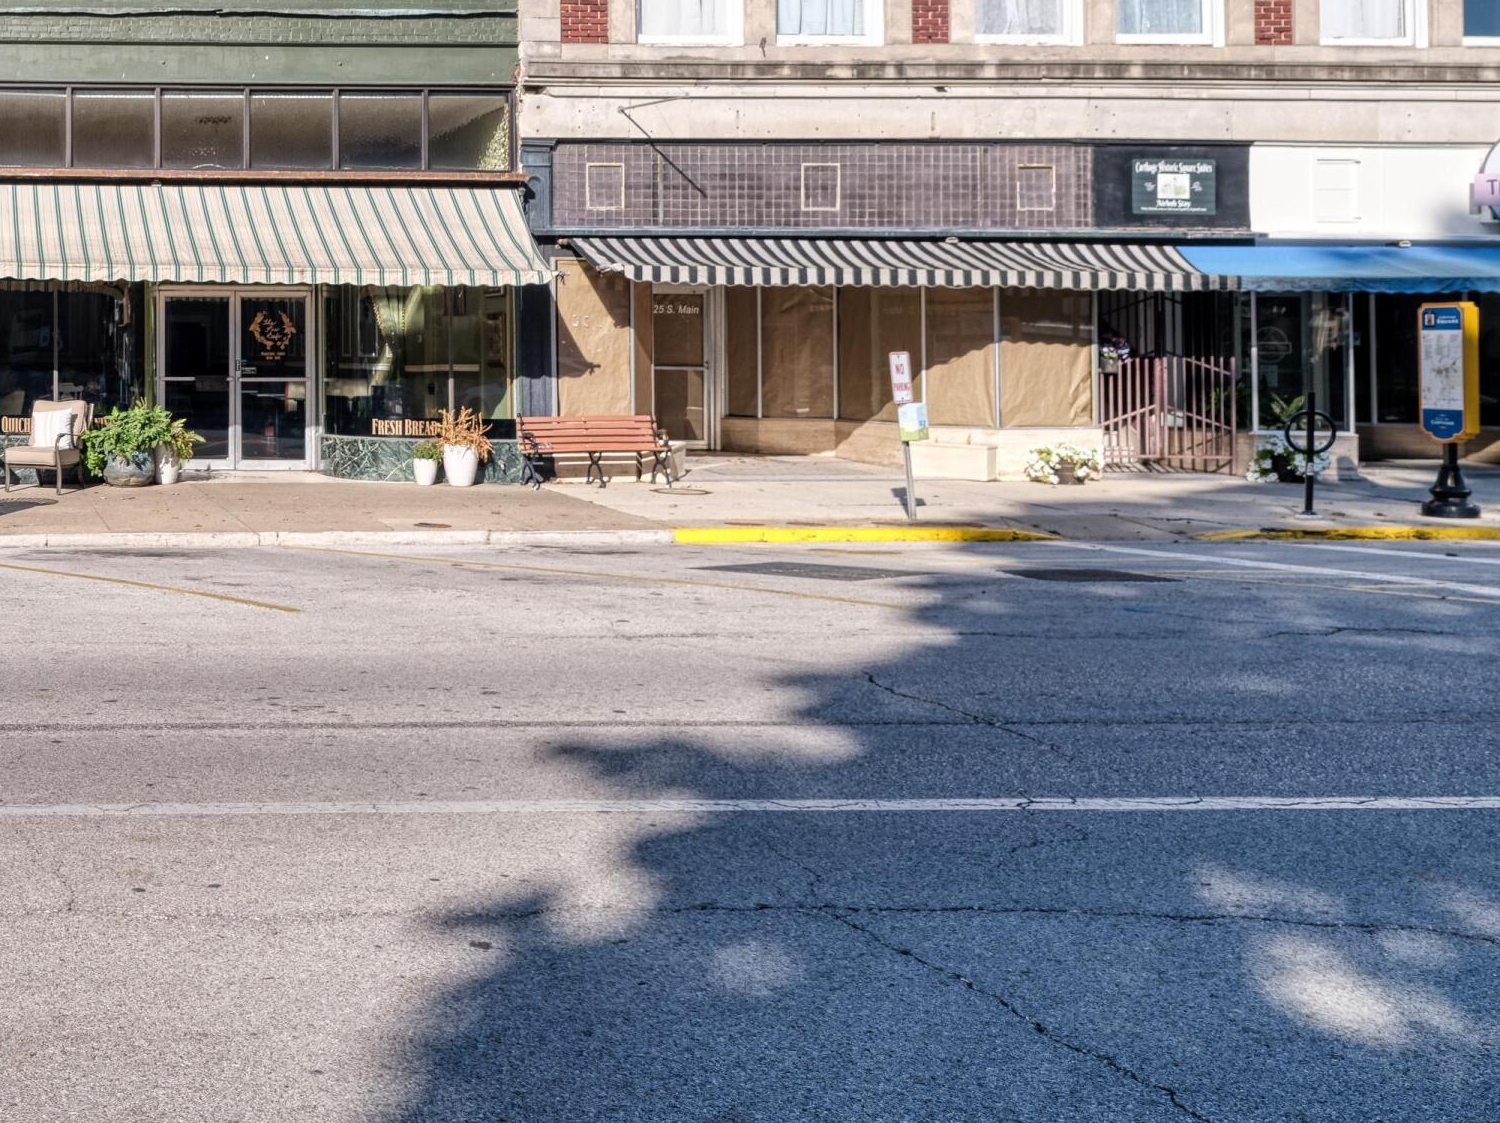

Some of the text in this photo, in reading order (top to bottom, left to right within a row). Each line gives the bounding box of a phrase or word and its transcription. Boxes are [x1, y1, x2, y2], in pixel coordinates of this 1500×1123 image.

[1135, 161, 1157, 174] Carthage
[667, 304, 675, 314] S.
[678, 304, 700, 314] Main
[1, 416, 32, 433] QUICH
[372, 418, 402, 436] FRESH
